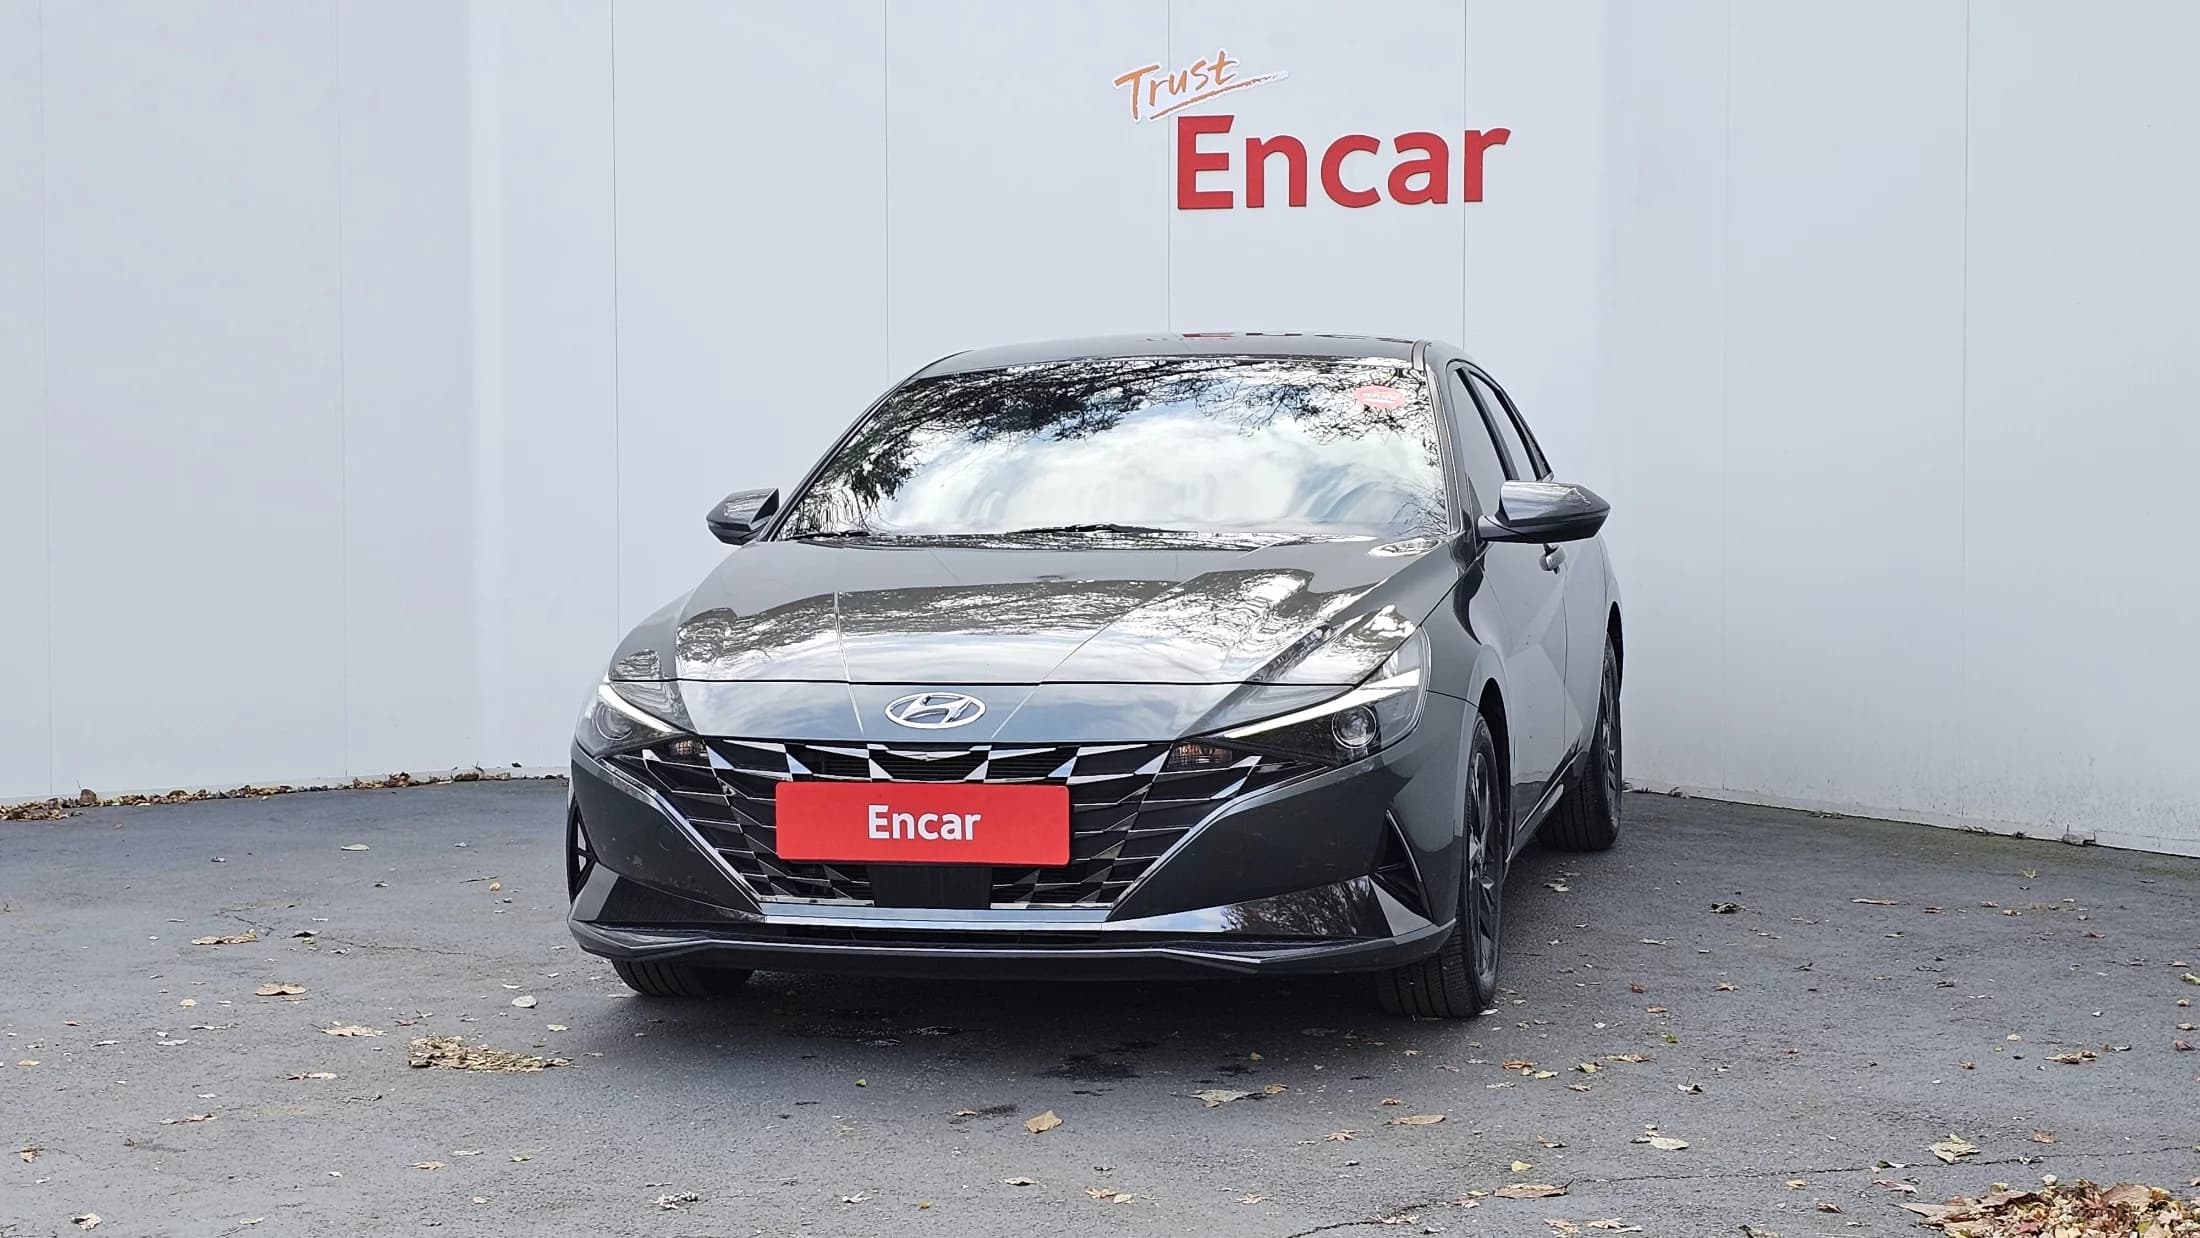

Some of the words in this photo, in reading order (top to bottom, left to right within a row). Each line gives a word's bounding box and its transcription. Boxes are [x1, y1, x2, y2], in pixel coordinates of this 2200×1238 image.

[1114, 50, 1238, 120] Trust
[1177, 114, 1511, 210] Encar
[867, 804, 982, 841] Encar
